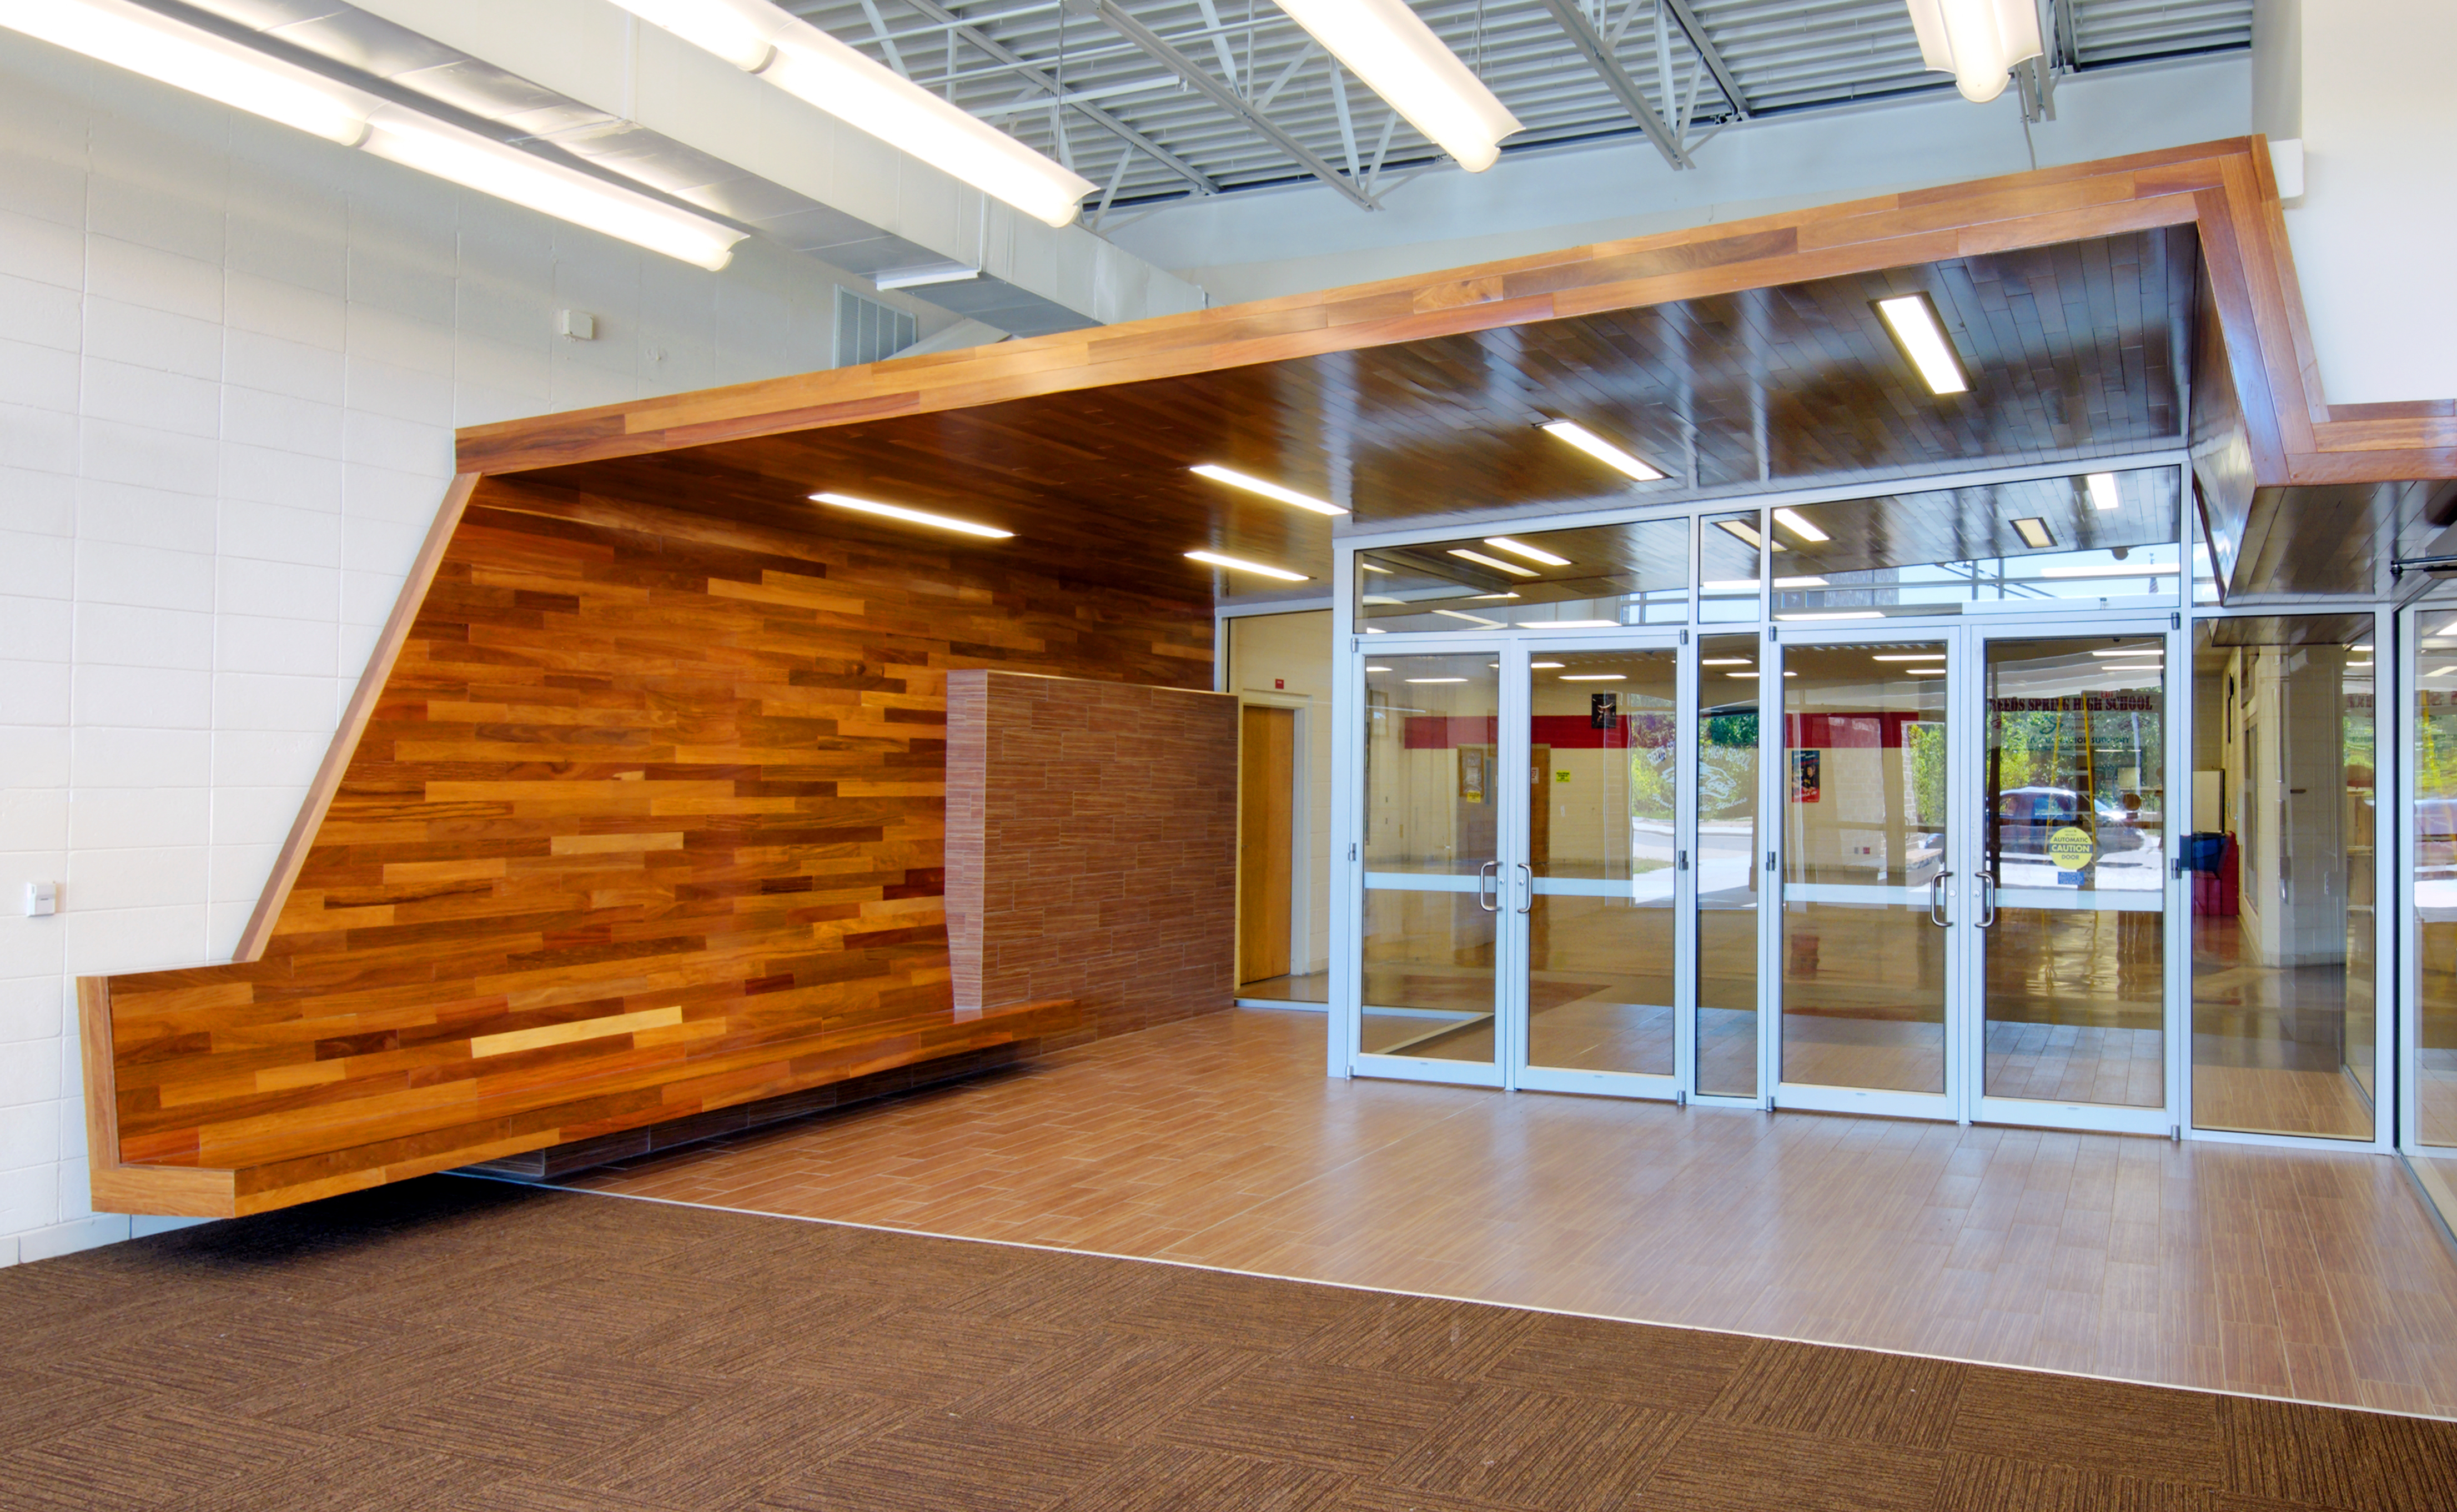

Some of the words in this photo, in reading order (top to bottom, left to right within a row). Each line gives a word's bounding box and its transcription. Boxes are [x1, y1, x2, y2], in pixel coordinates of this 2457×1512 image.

[1989, 697, 2025, 711] REEDS
[2073, 697, 2102, 711] HGH
[2106, 696, 2153, 710] SCHOOL
